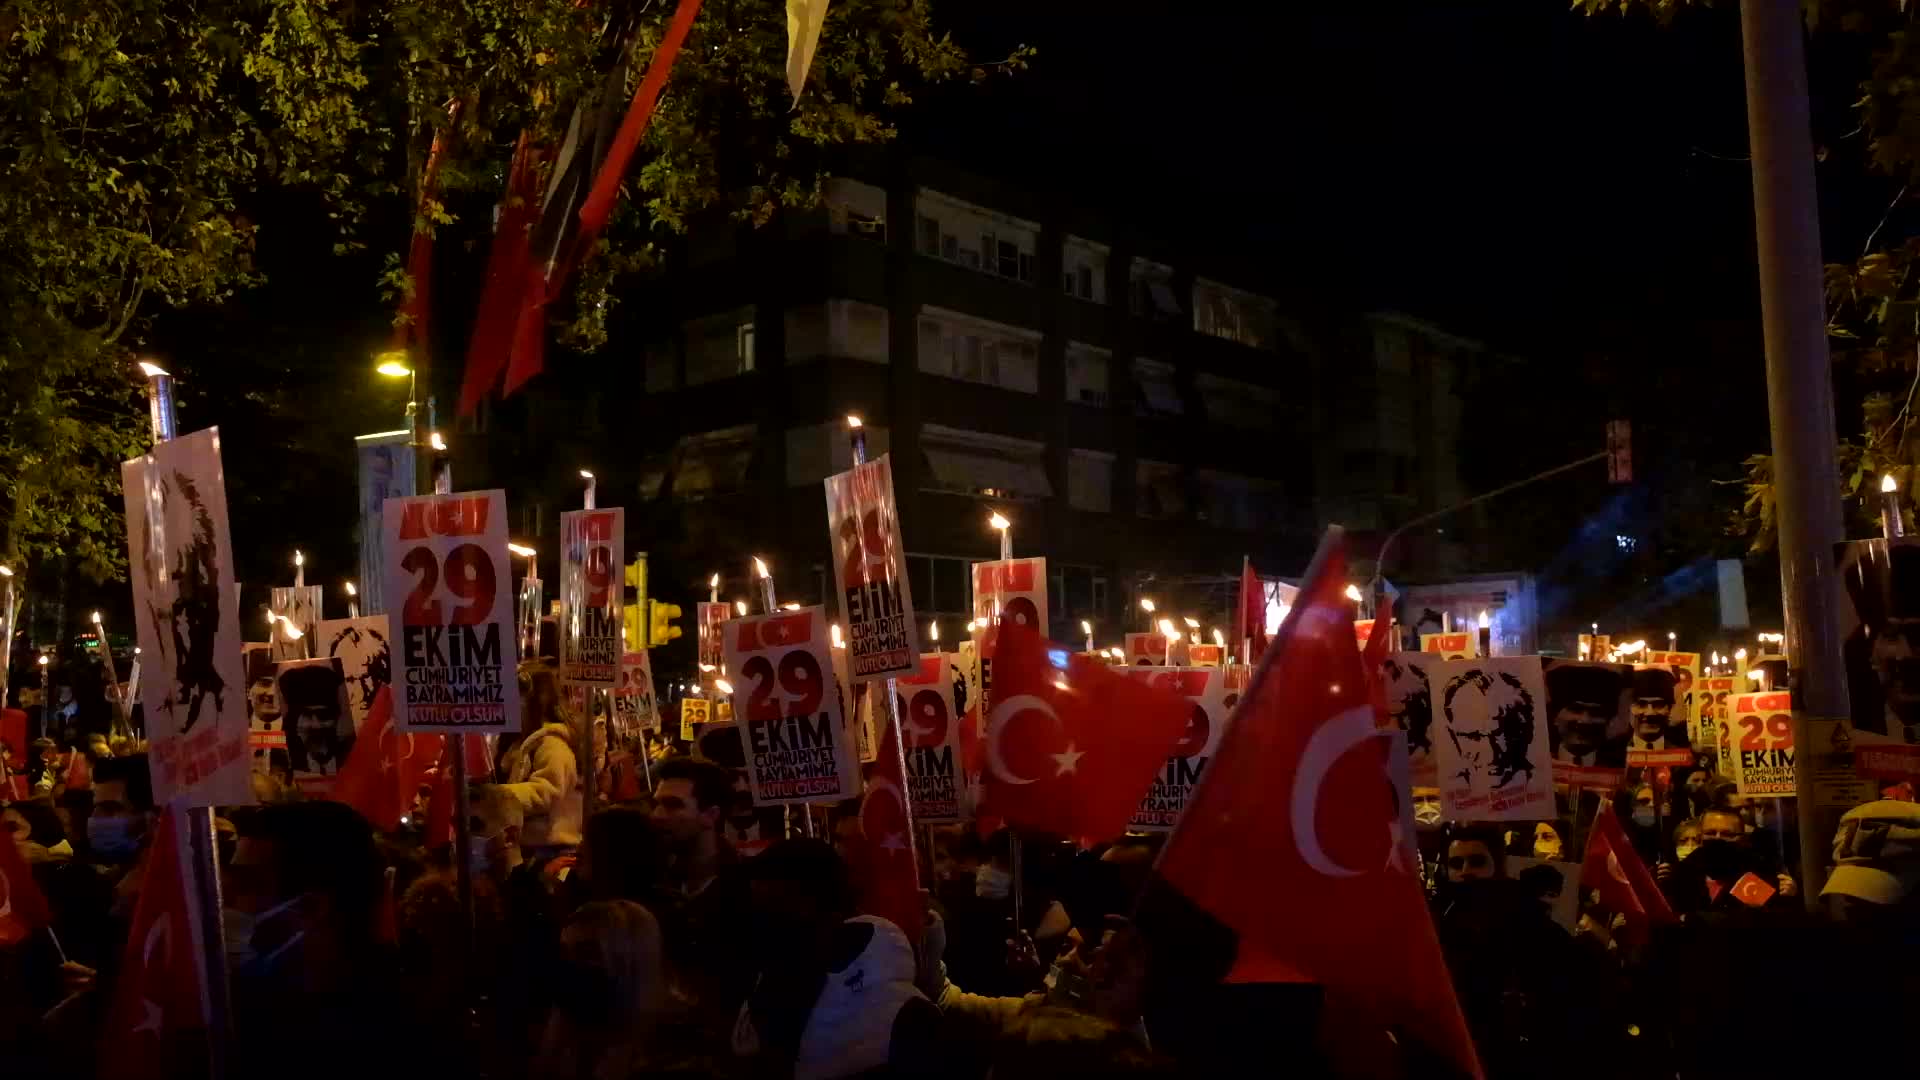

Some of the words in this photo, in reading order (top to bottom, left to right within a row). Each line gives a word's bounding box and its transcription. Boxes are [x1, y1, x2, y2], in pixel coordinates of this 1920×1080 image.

[401, 543, 497, 626] 29
[741, 650, 823, 721] 29
[449, 705, 504, 723] OLSUN
[1738, 714, 1794, 751] 29
